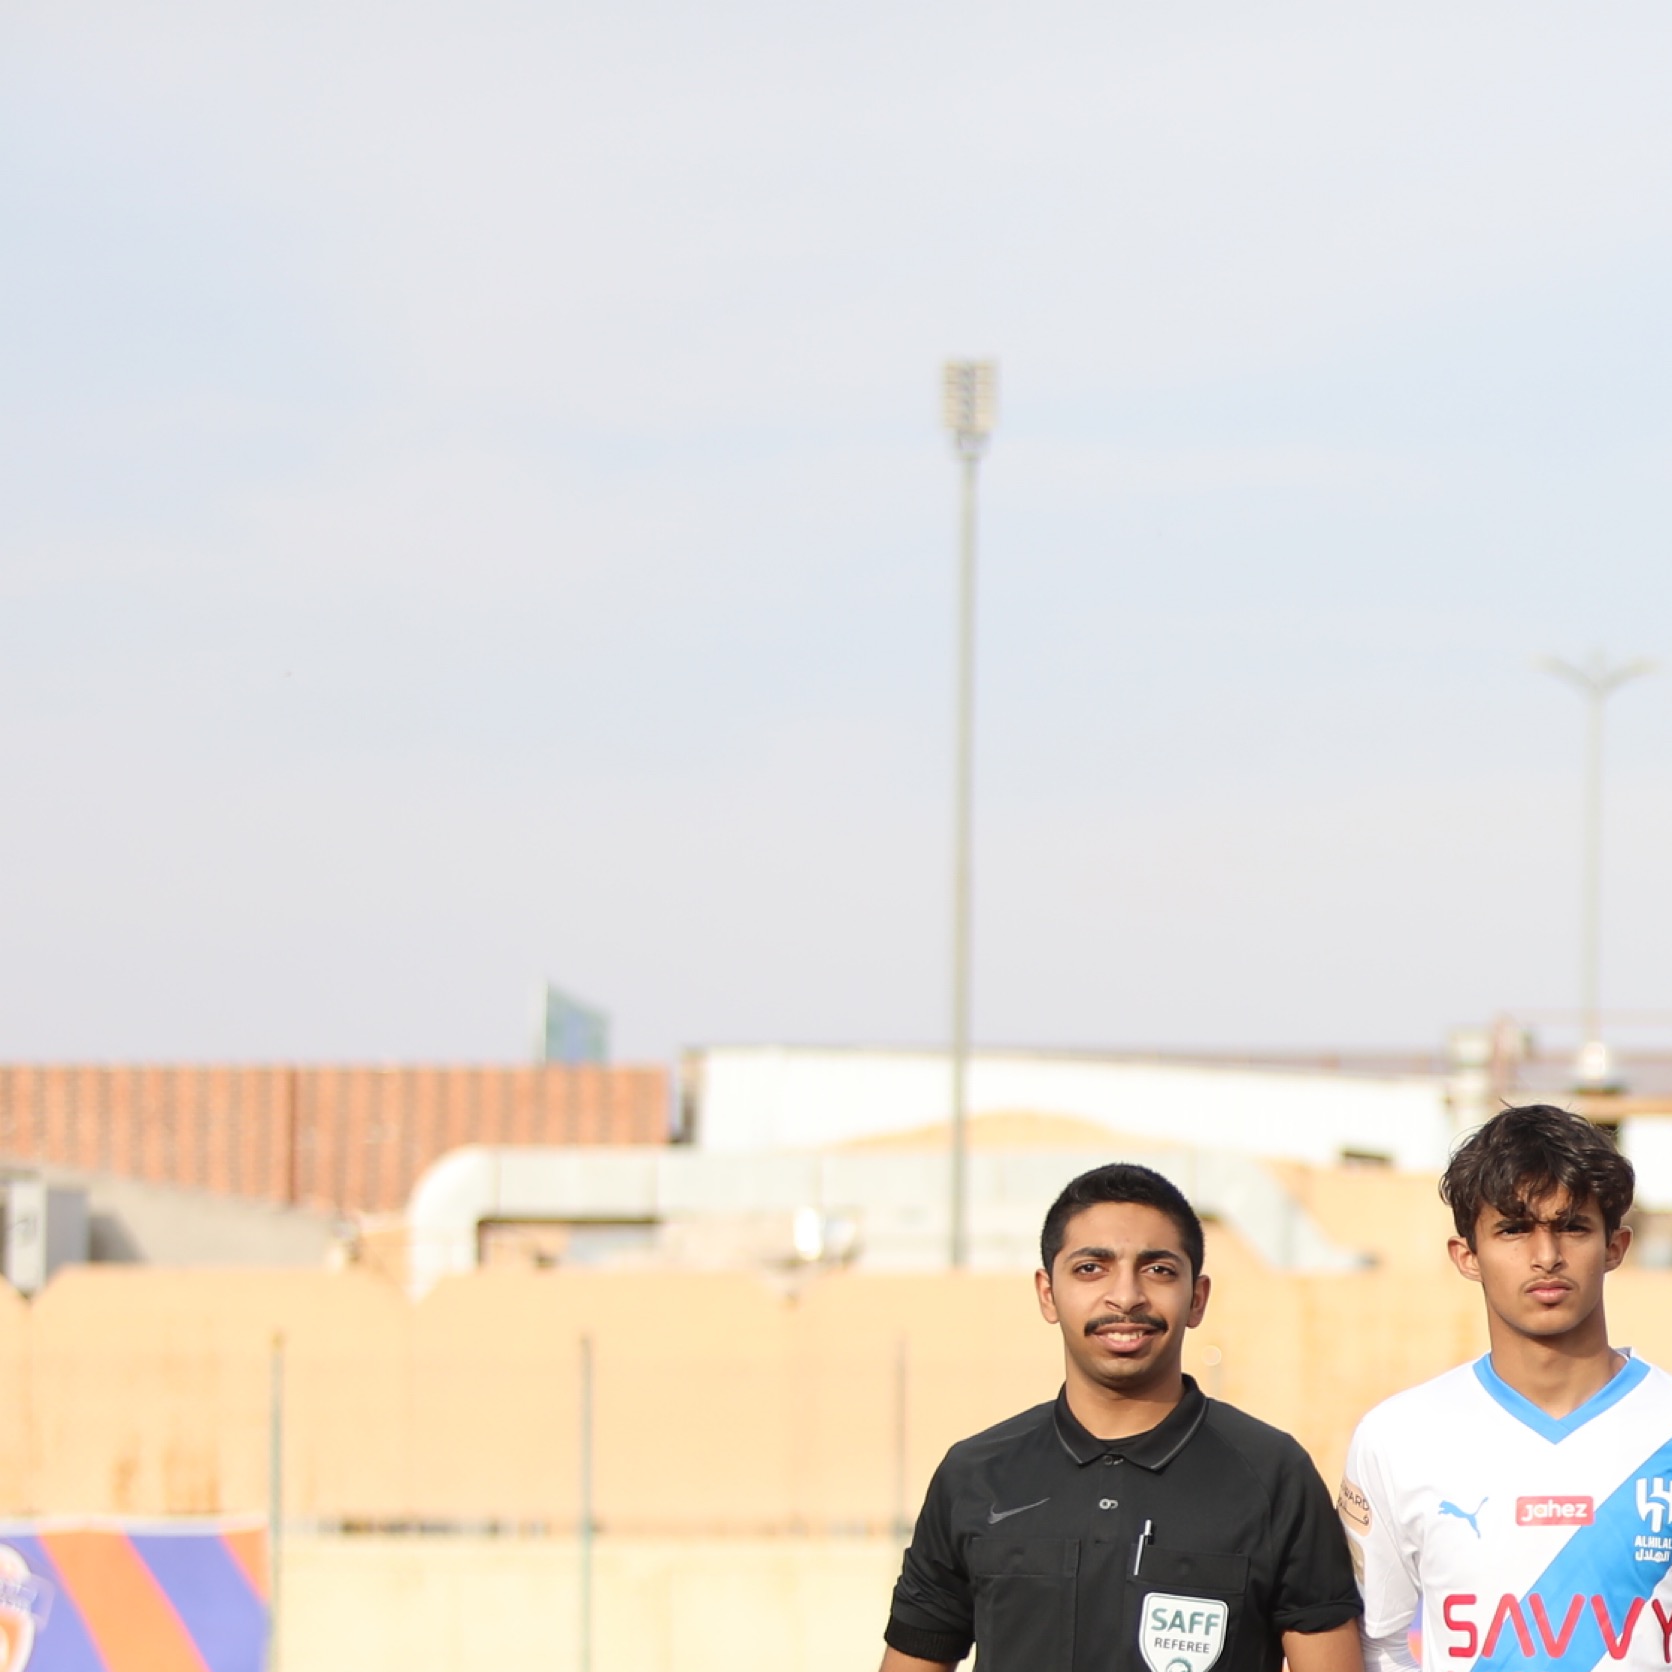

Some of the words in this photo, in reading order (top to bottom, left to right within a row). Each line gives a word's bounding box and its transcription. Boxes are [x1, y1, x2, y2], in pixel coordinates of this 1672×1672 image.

[1520, 1499, 1588, 1521] jahez
[1151, 1608, 1221, 1636] SAFF
[1154, 1637, 1210, 1654] REFEREE
